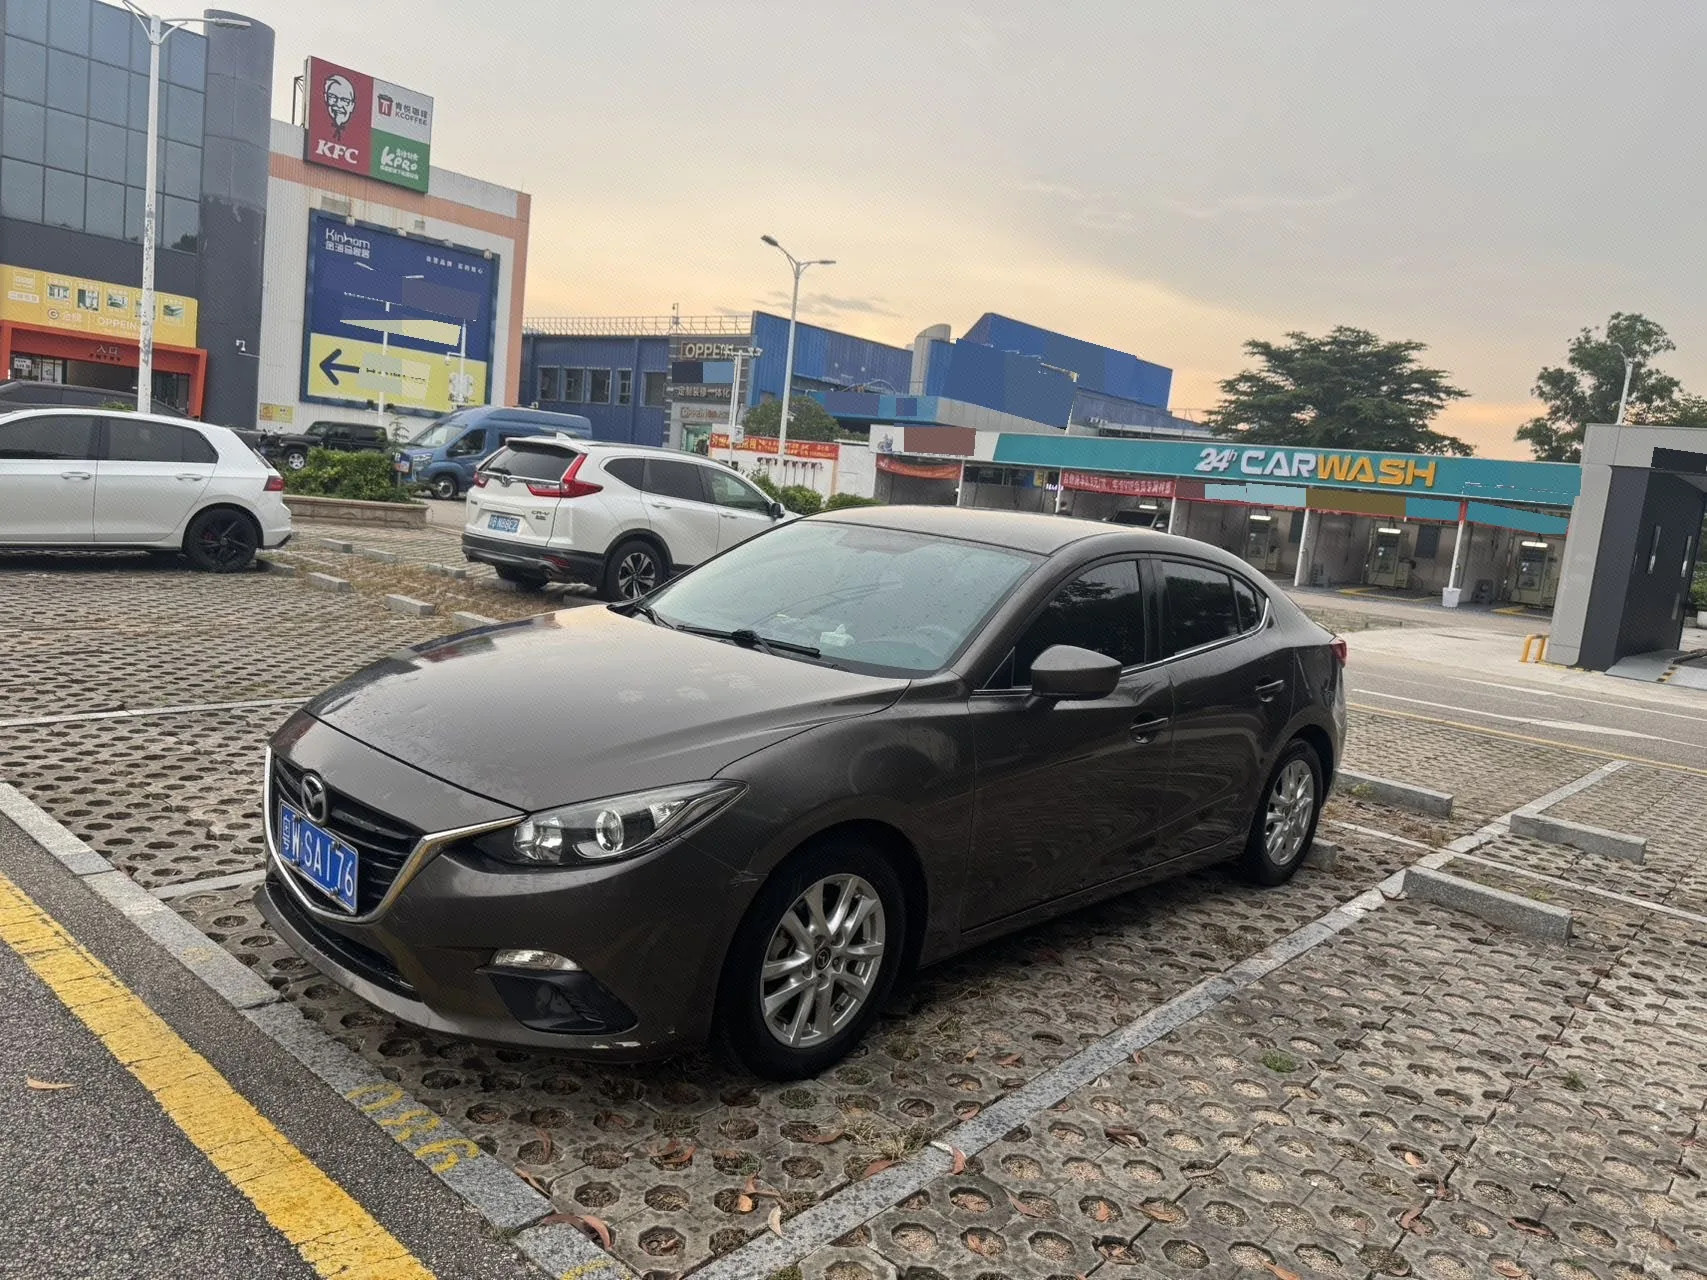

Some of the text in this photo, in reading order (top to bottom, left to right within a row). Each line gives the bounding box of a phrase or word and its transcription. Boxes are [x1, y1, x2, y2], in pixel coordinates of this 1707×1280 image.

[394, 112, 428, 126] KCOFFEE
[315, 139, 360, 165] KFC
[96, 344, 119, 355] 入口
